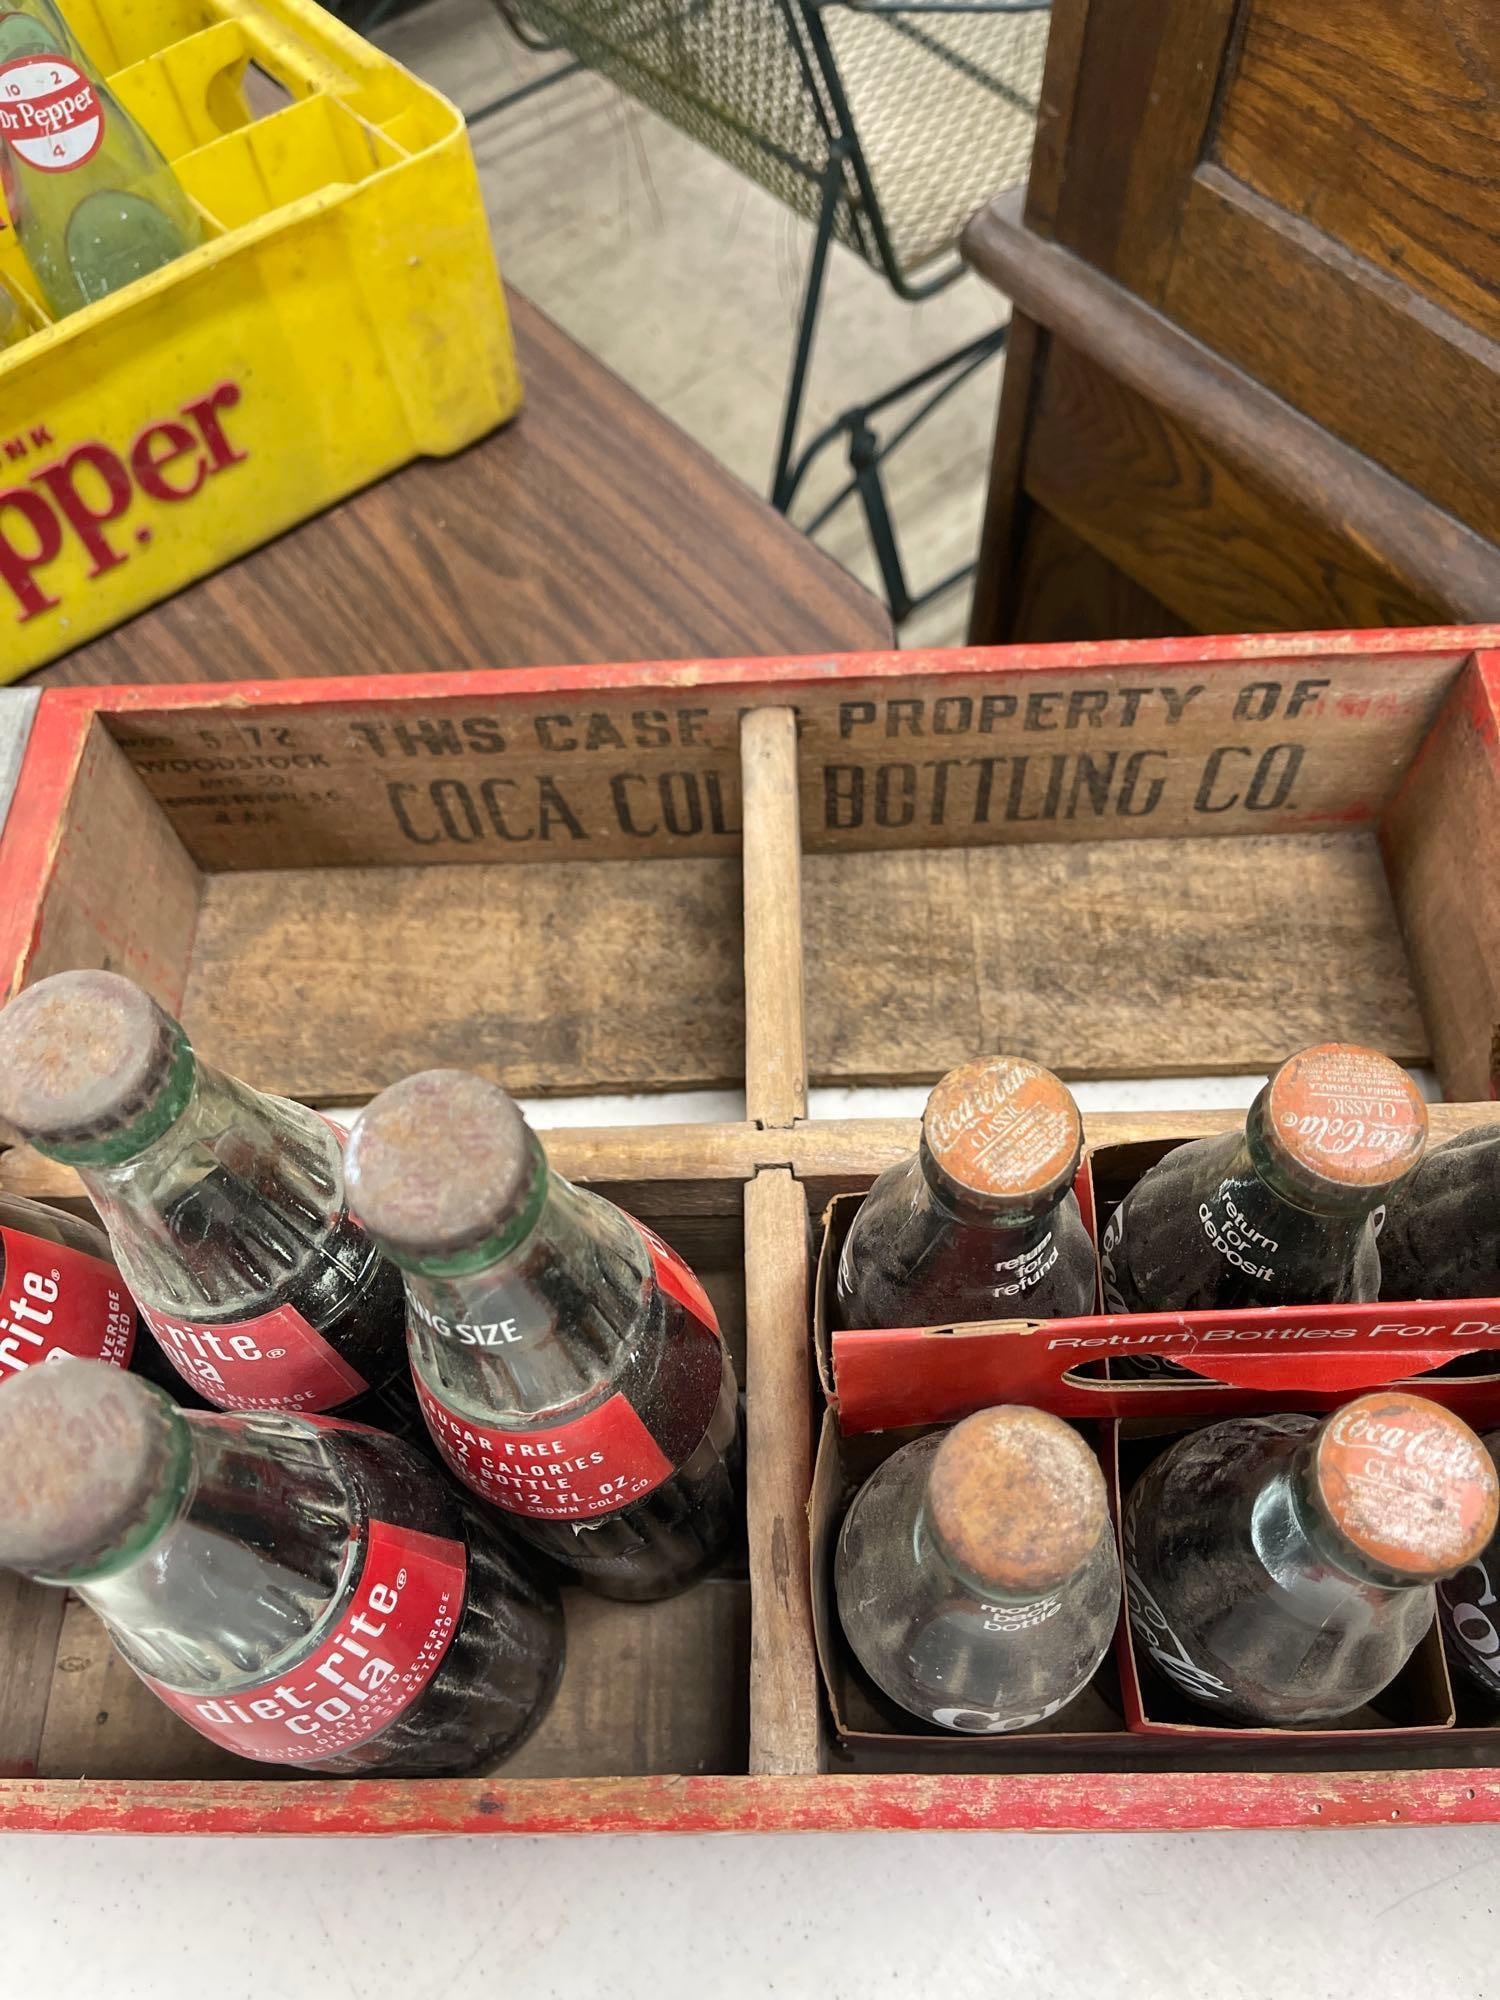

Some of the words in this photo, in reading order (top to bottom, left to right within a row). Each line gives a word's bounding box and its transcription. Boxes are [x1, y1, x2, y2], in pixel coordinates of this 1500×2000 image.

[5, 84, 20, 97] 10
[50, 71, 62, 85] 2
[0, 109, 19, 129] Dr
[16, 86, 93, 131] Pepper
[53, 145, 65, 157] 4
[838, 685, 1206, 740] PROPERTY
[1232, 678, 1331, 723] OF
[350, 716, 507, 759] THIS
[535, 708, 711, 754] CASE
[387, 776, 590, 846] COCA
[609, 768, 742, 838] COL
[822, 747, 1169, 830] BOTTLING
[1193, 742, 1308, 814] CO.
[970, 1099, 1025, 1149] CLASSIC
[1327, 1098, 1397, 1118] CLASSIC
[1199, 1203, 1275, 1282] deposit
[1220, 1220, 1252, 1251] for
[1222, 1191, 1279, 1253] return
[993, 1246, 1059, 1298] refund
[995, 1231, 1052, 1272] return
[1016, 1252, 1045, 1278] for
[98, 1289, 120, 1366] VERAGE
[454, 1318, 523, 1345] SIZE
[1048, 1331, 1194, 1350] Return
[1202, 1324, 1358, 1342] Bottles
[1368, 1321, 1447, 1338] For
[428, 1399, 493, 1452] SUGAR
[505, 1440, 567, 1457] FREE
[456, 1439, 470, 1458] 2
[481, 1451, 604, 1477] CALORIES
[480, 1467, 571, 1490] BOTTLE
[513, 1491, 543, 1504] 12
[556, 1491, 593, 1504] FL.
[599, 1475, 637, 1495] OZ.
[527, 1505, 580, 1515] CROWN
[588, 1493, 624, 1511] COLA
[983, 1602, 1062, 1632] bottle
[317, 1694, 394, 1746] DIETARY
[402, 1591, 450, 1684] BEVERAGE
[383, 1616, 453, 1719] SWEETENED
[285, 1657, 396, 1735] cola
[311, 1673, 400, 1739] FLAVORED
